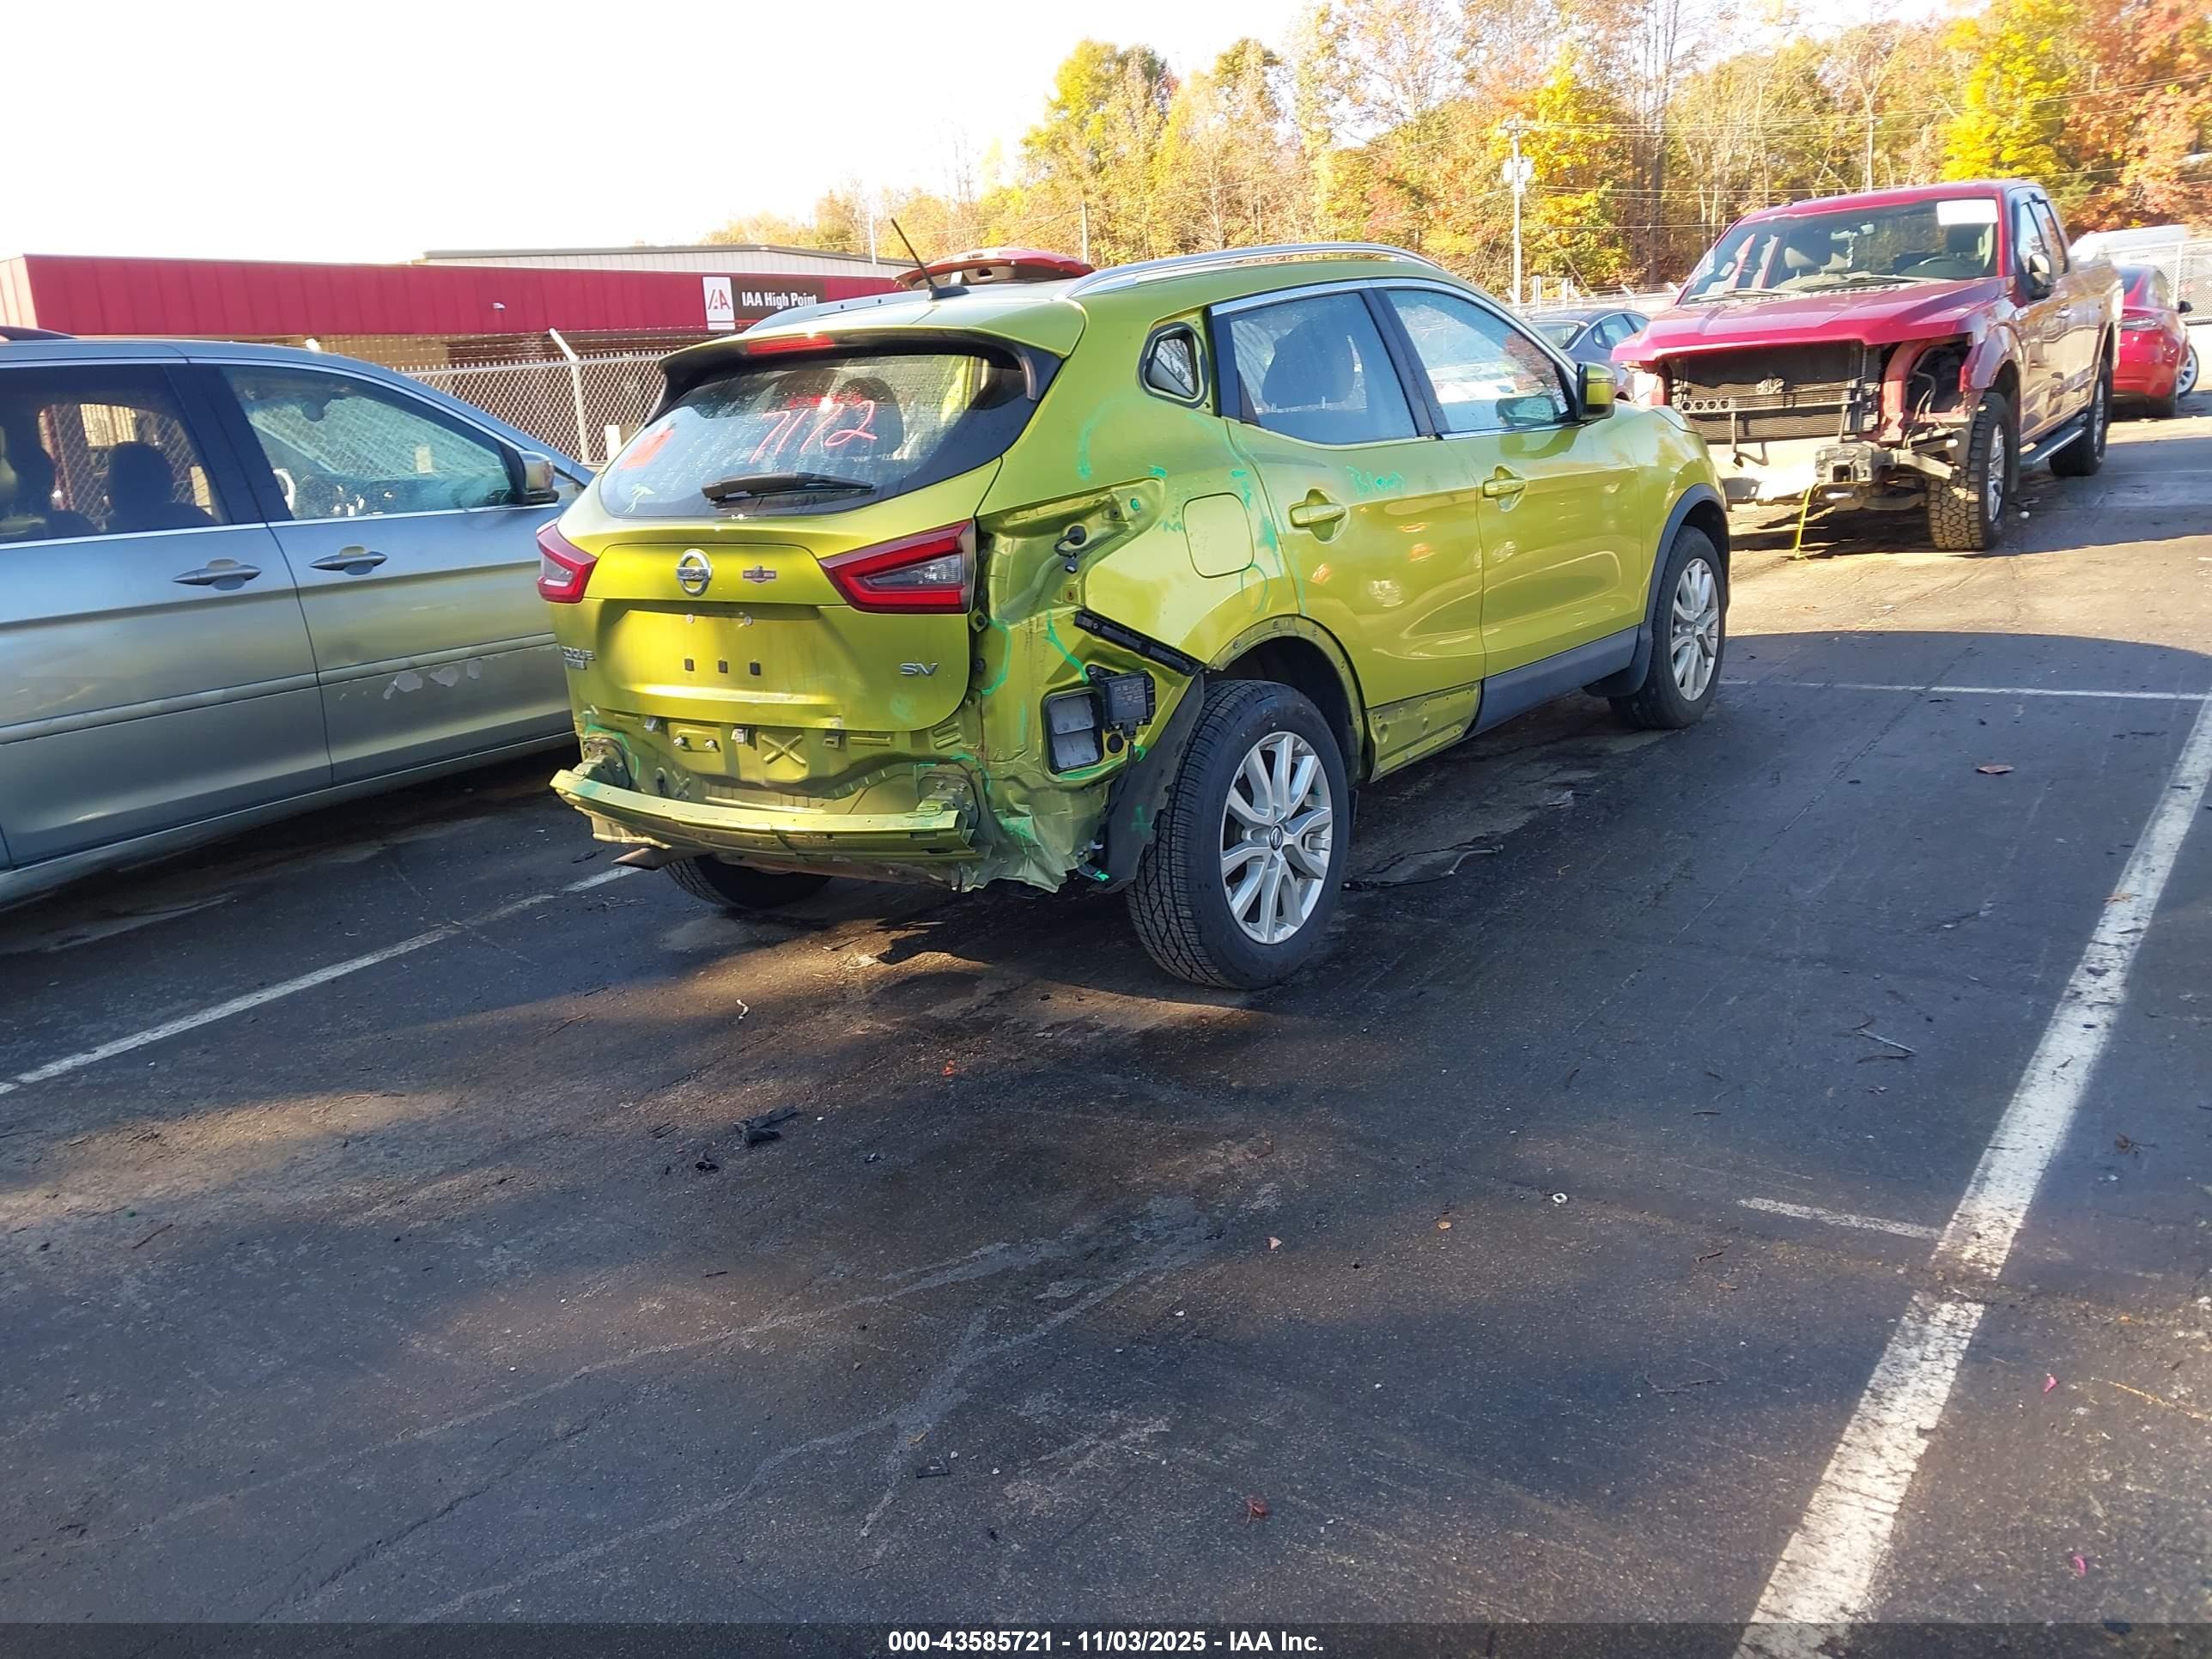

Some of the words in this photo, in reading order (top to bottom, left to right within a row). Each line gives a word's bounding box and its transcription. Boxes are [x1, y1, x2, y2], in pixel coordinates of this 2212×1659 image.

[741, 291, 763, 307] IAA
[764, 292, 789, 310] High
[790, 292, 817, 307] Point
[899, 662, 939, 676] SV
